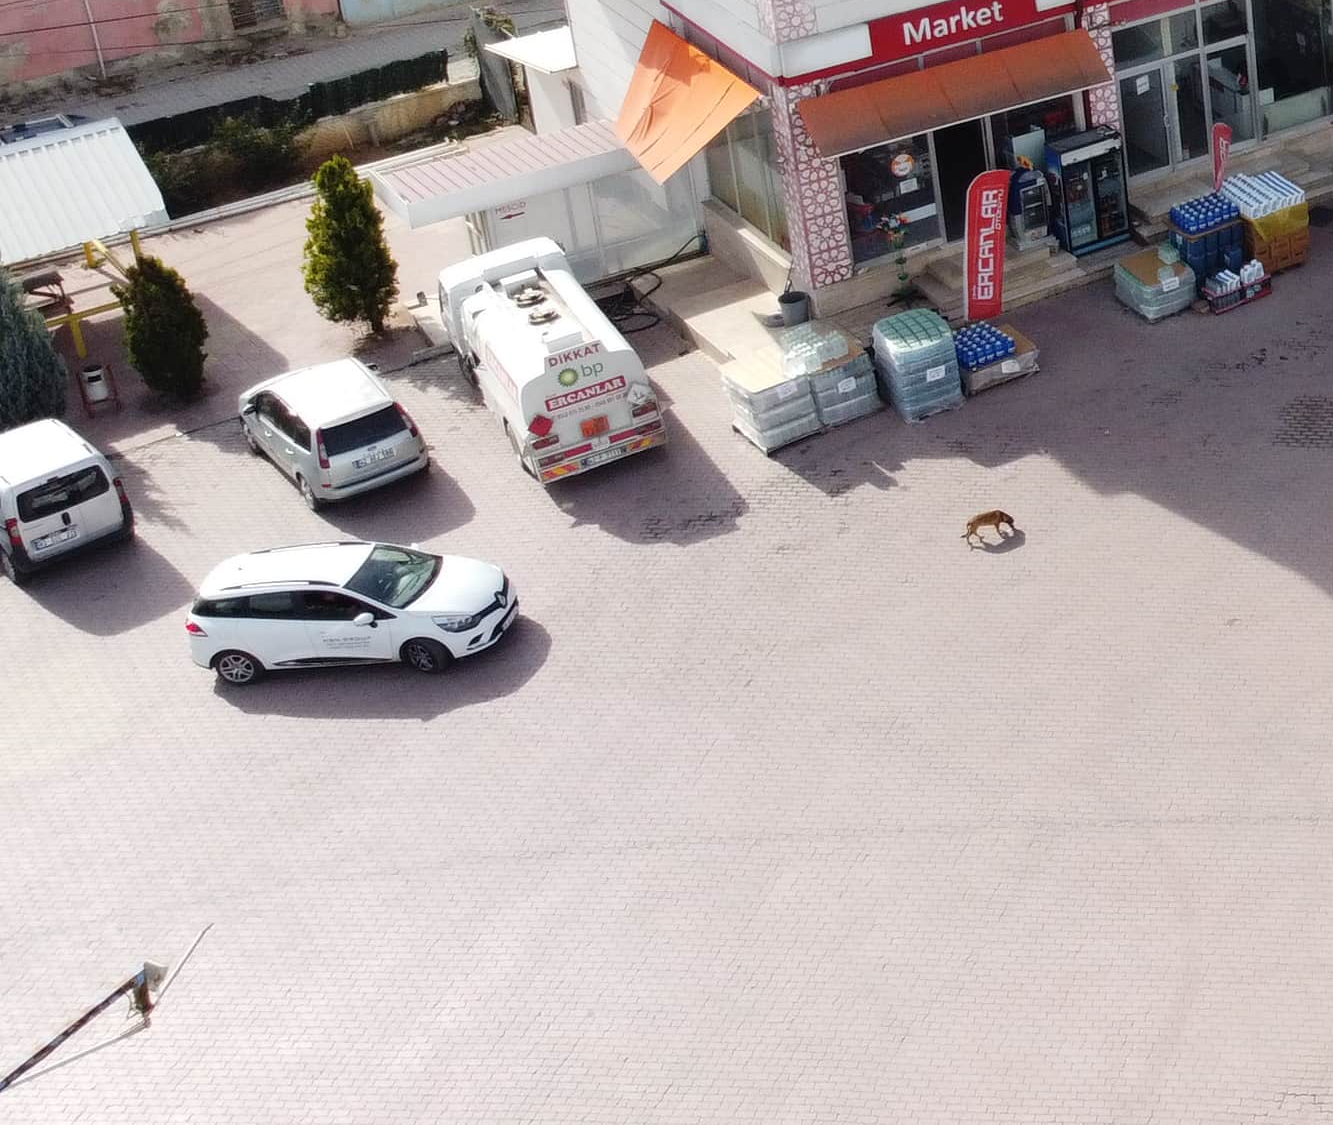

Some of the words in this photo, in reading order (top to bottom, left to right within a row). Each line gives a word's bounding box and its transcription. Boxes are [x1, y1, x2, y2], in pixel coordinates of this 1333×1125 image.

[903, 1, 1004, 45] Market
[977, 189, 998, 300] ERCANLAR
[548, 343, 601, 367] DİKKAT
[581, 362, 604, 378] bp
[548, 376, 625, 410] ERCANLAR
